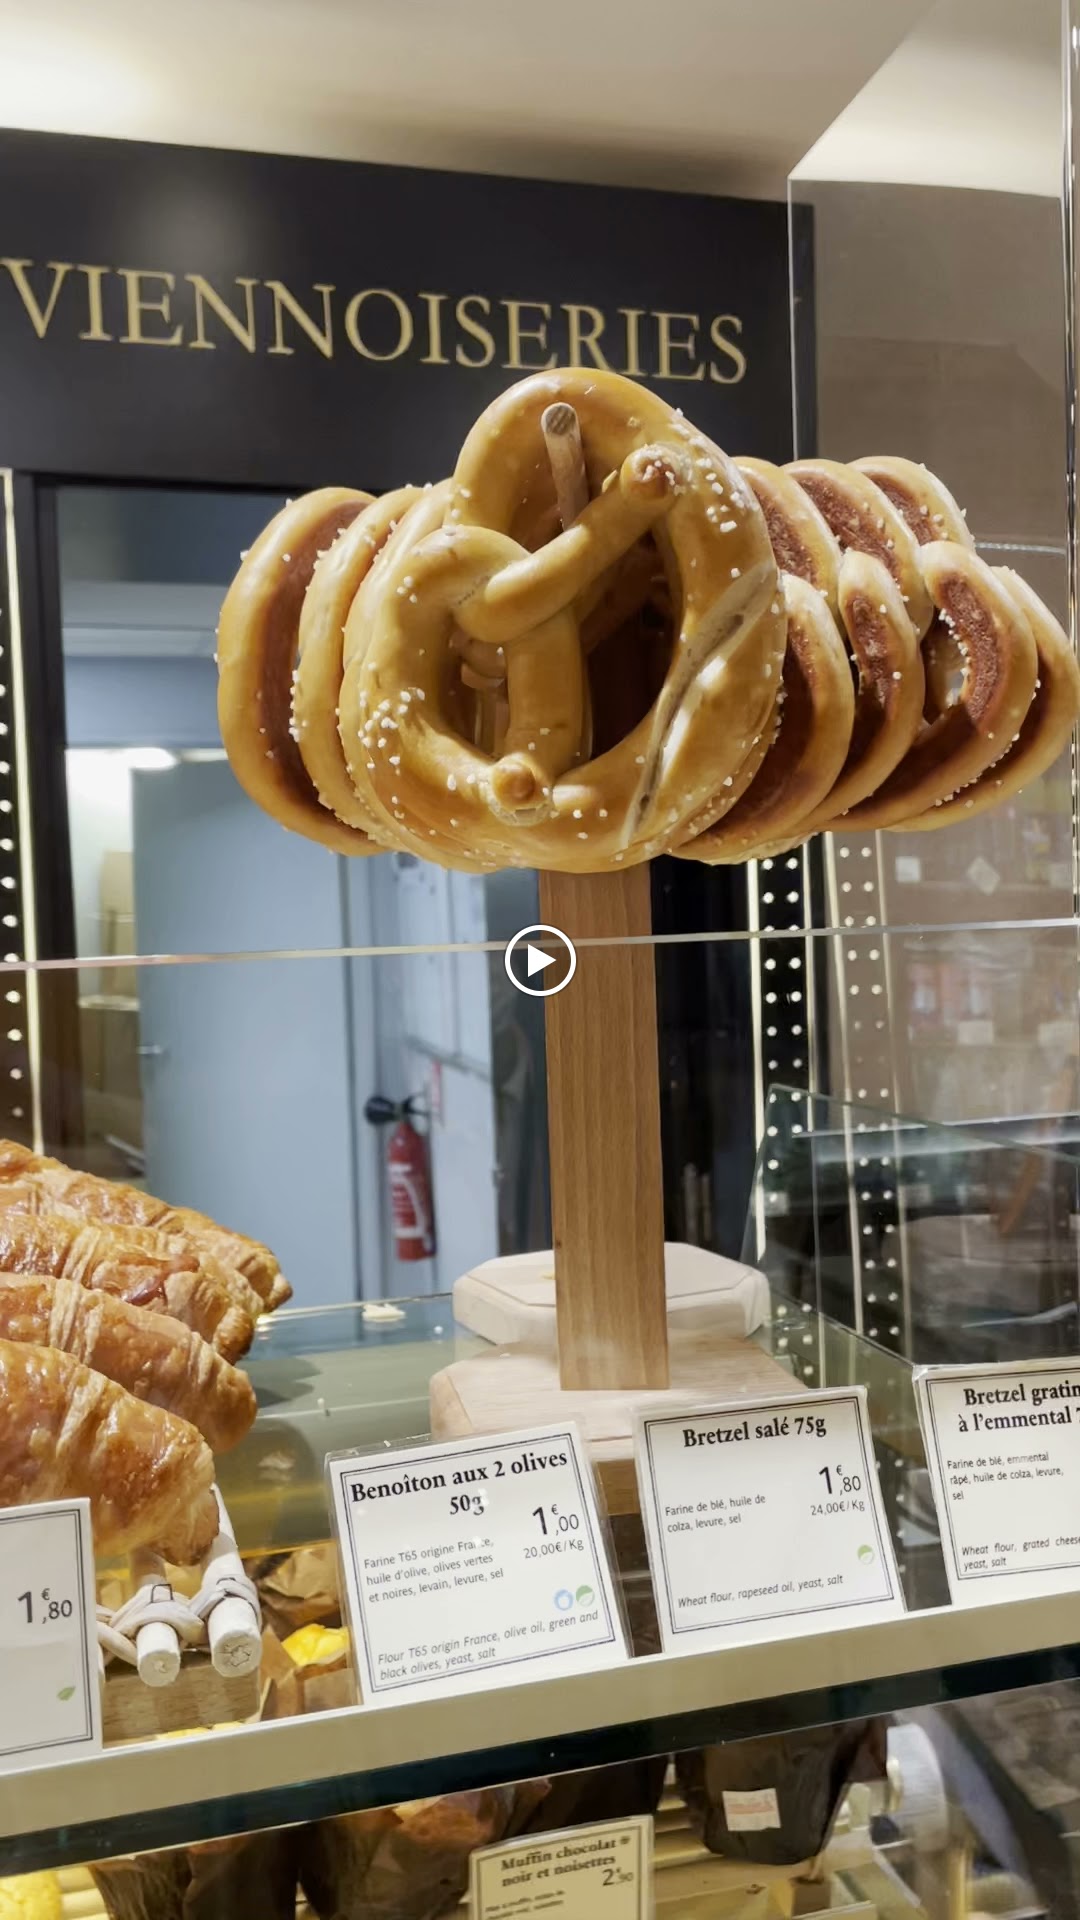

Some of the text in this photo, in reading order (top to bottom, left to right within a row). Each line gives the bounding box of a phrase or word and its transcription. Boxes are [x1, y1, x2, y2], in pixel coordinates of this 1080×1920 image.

[0, 257, 748, 386] VIENNOISERIES
[963, 1380, 1080, 1406] Bretzel gratin
[683, 1415, 827, 1448] Bretzel salé 75g
[958, 1414, 969, 1433] à
[974, 1406, 1072, 1431] l'emmental
[947, 1452, 1049, 1470] Farine de blé, emmental
[950, 1465, 1064, 1486] râpé, huile de colza, levure,
[350, 1452, 568, 1502] Benoîton aux 2 olives
[450, 1494, 485, 1516] 50g
[665, 1493, 766, 1517] Farine de blé, huile de
[952, 1490, 964, 1501] sel
[667, 1513, 742, 1533] colza, levure, sel
[363, 1538, 494, 1569] Farine T65 origine Frae,
[961, 1544, 989, 1557] Wheat
[994, 1542, 1017, 1553] flour,
[1023, 1537, 1050, 1552] grated
[366, 1553, 494, 1586] huile d'olive, olives vertes
[964, 1557, 1007, 1572] yeast, salt
[369, 1568, 504, 1603] et noires, levain, levure, sel
[678, 1574, 844, 1608] Wheat flour, rapeseed oil, yeast, salt
[378, 1610, 599, 1665] Flour T65 origin France, olive oil, green and
[380, 1647, 496, 1680] black olives, yeast, salt
[500, 1839, 616, 1871] Muffin chocolat
[502, 1856, 615, 1887] noir et noisettes
